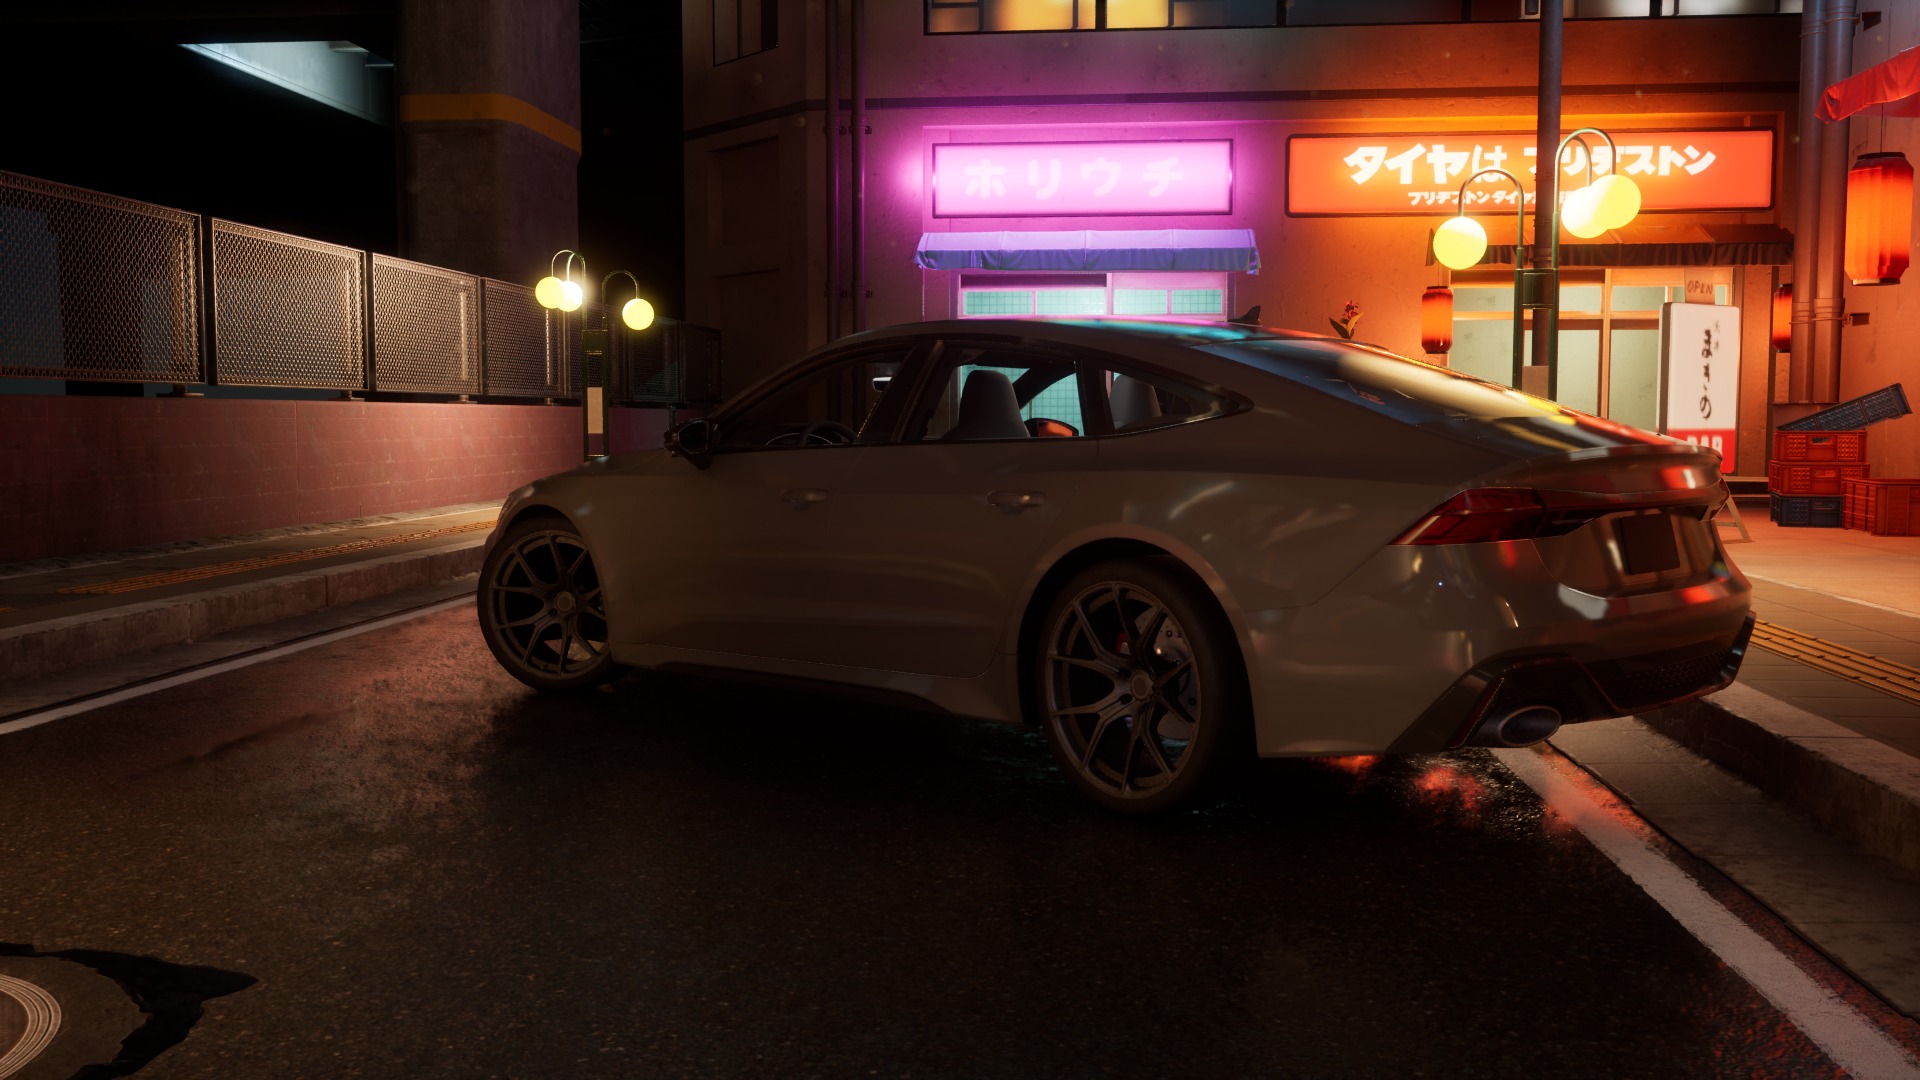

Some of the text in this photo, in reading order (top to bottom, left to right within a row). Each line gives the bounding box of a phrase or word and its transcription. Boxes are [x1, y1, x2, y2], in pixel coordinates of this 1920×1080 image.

[964, 156, 1185, 200] ホリウチ
[1343, 143, 1508, 185] タイヤは
[1687, 280, 1713, 295] OPEN
